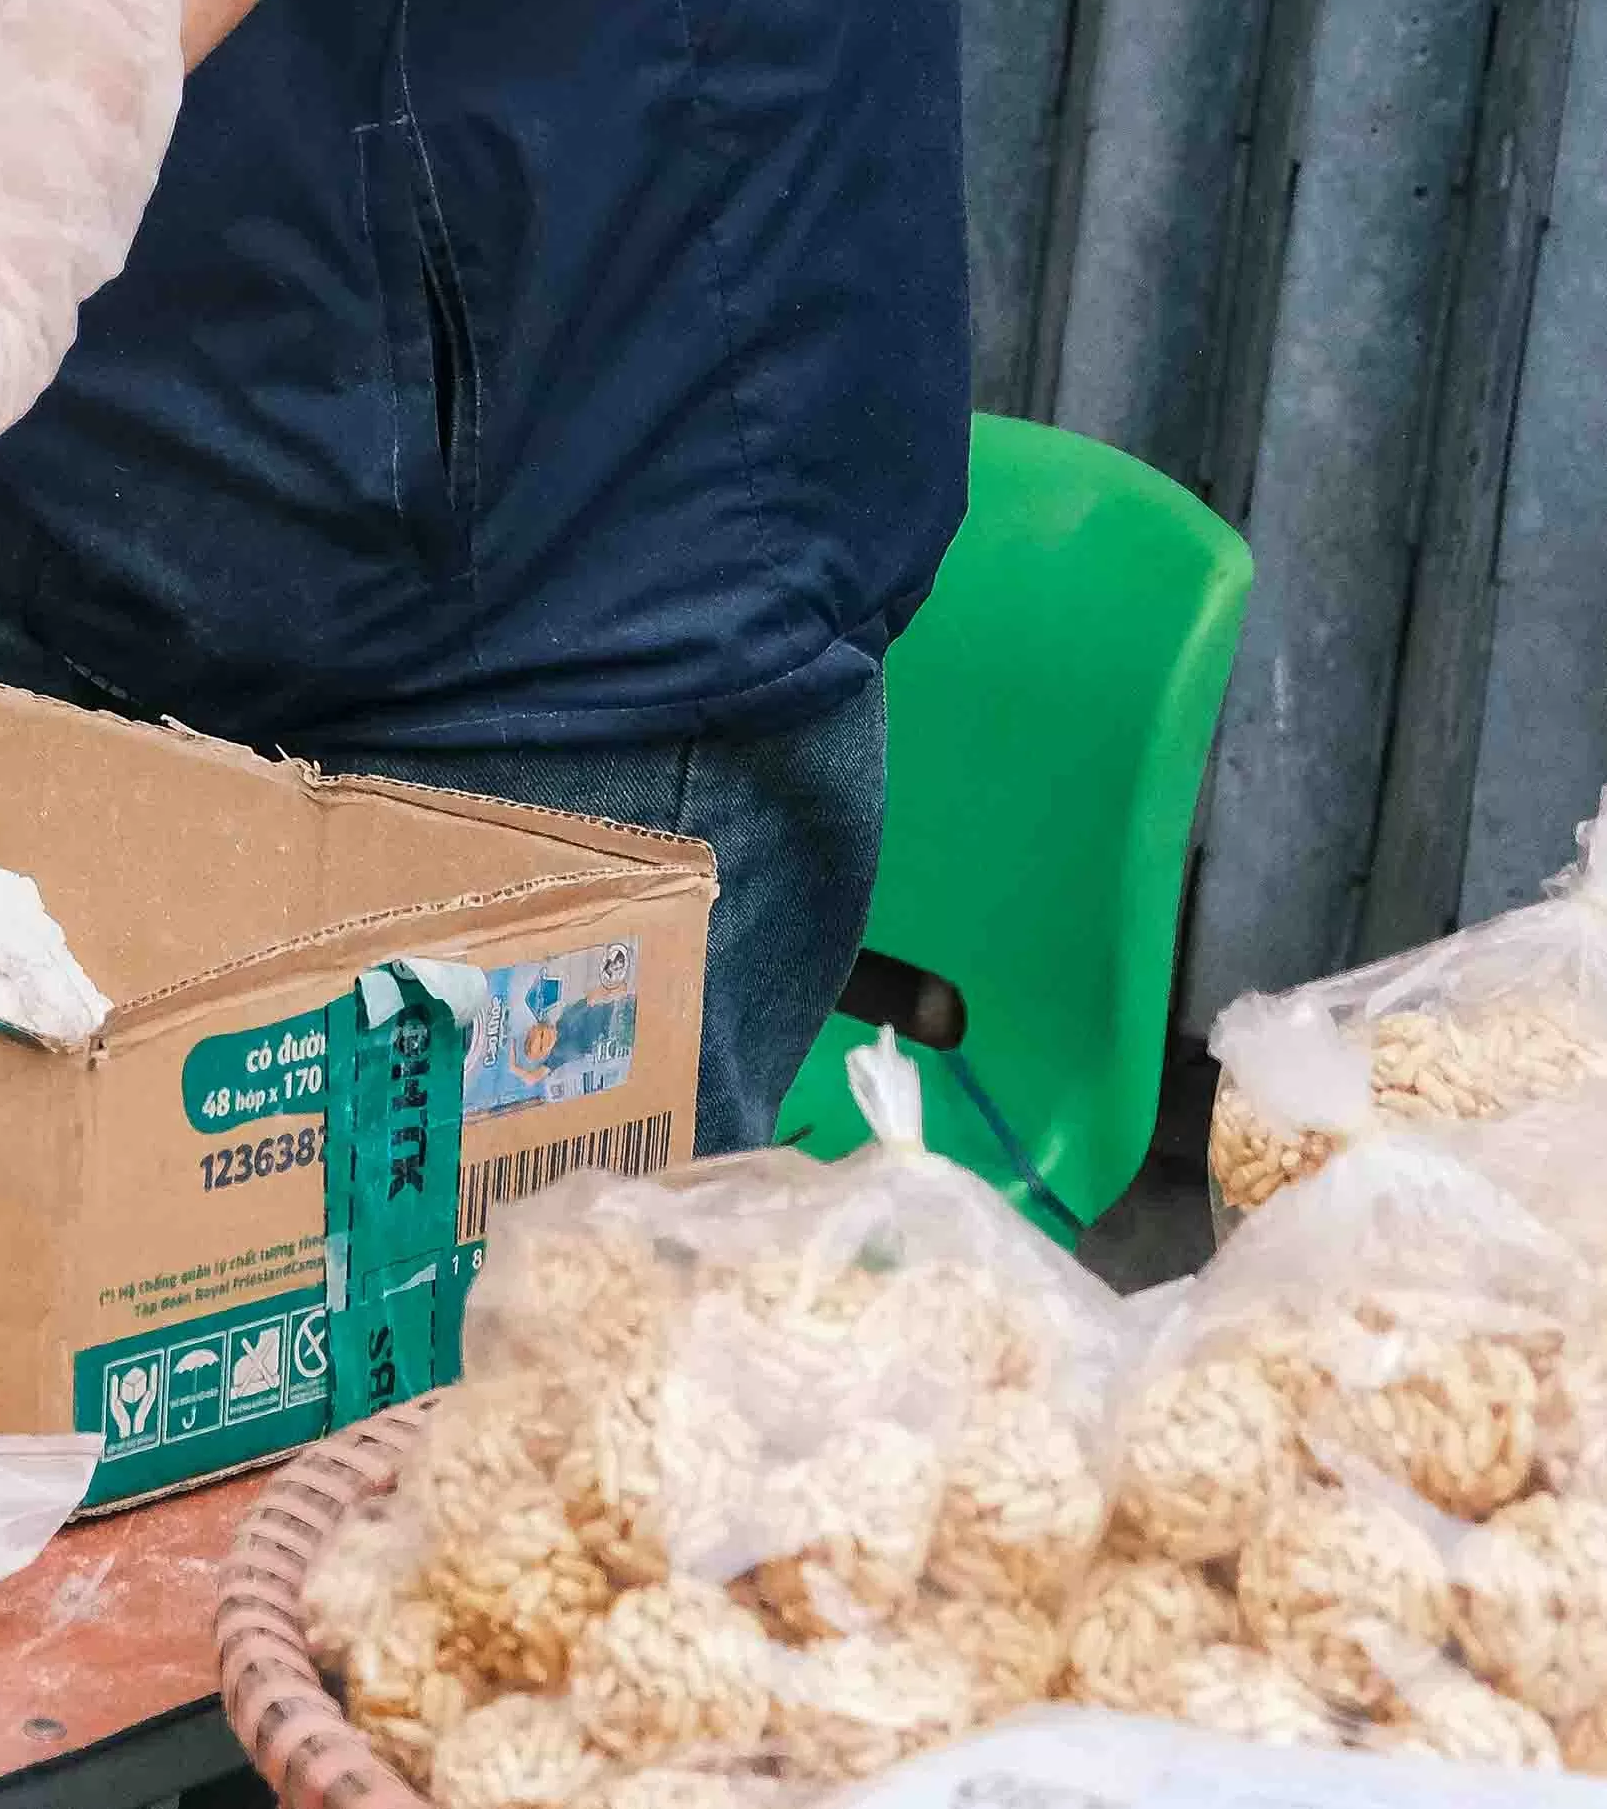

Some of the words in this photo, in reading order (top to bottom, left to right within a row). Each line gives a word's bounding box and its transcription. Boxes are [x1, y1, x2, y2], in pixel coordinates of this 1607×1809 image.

[246, 1039, 273, 1073] có
[201, 1087, 231, 1119] 48
[267, 1087, 278, 1104] x
[283, 1064, 322, 1099] 170
[451, 1254, 460, 1275] 1
[471, 1248, 483, 1269] 8
